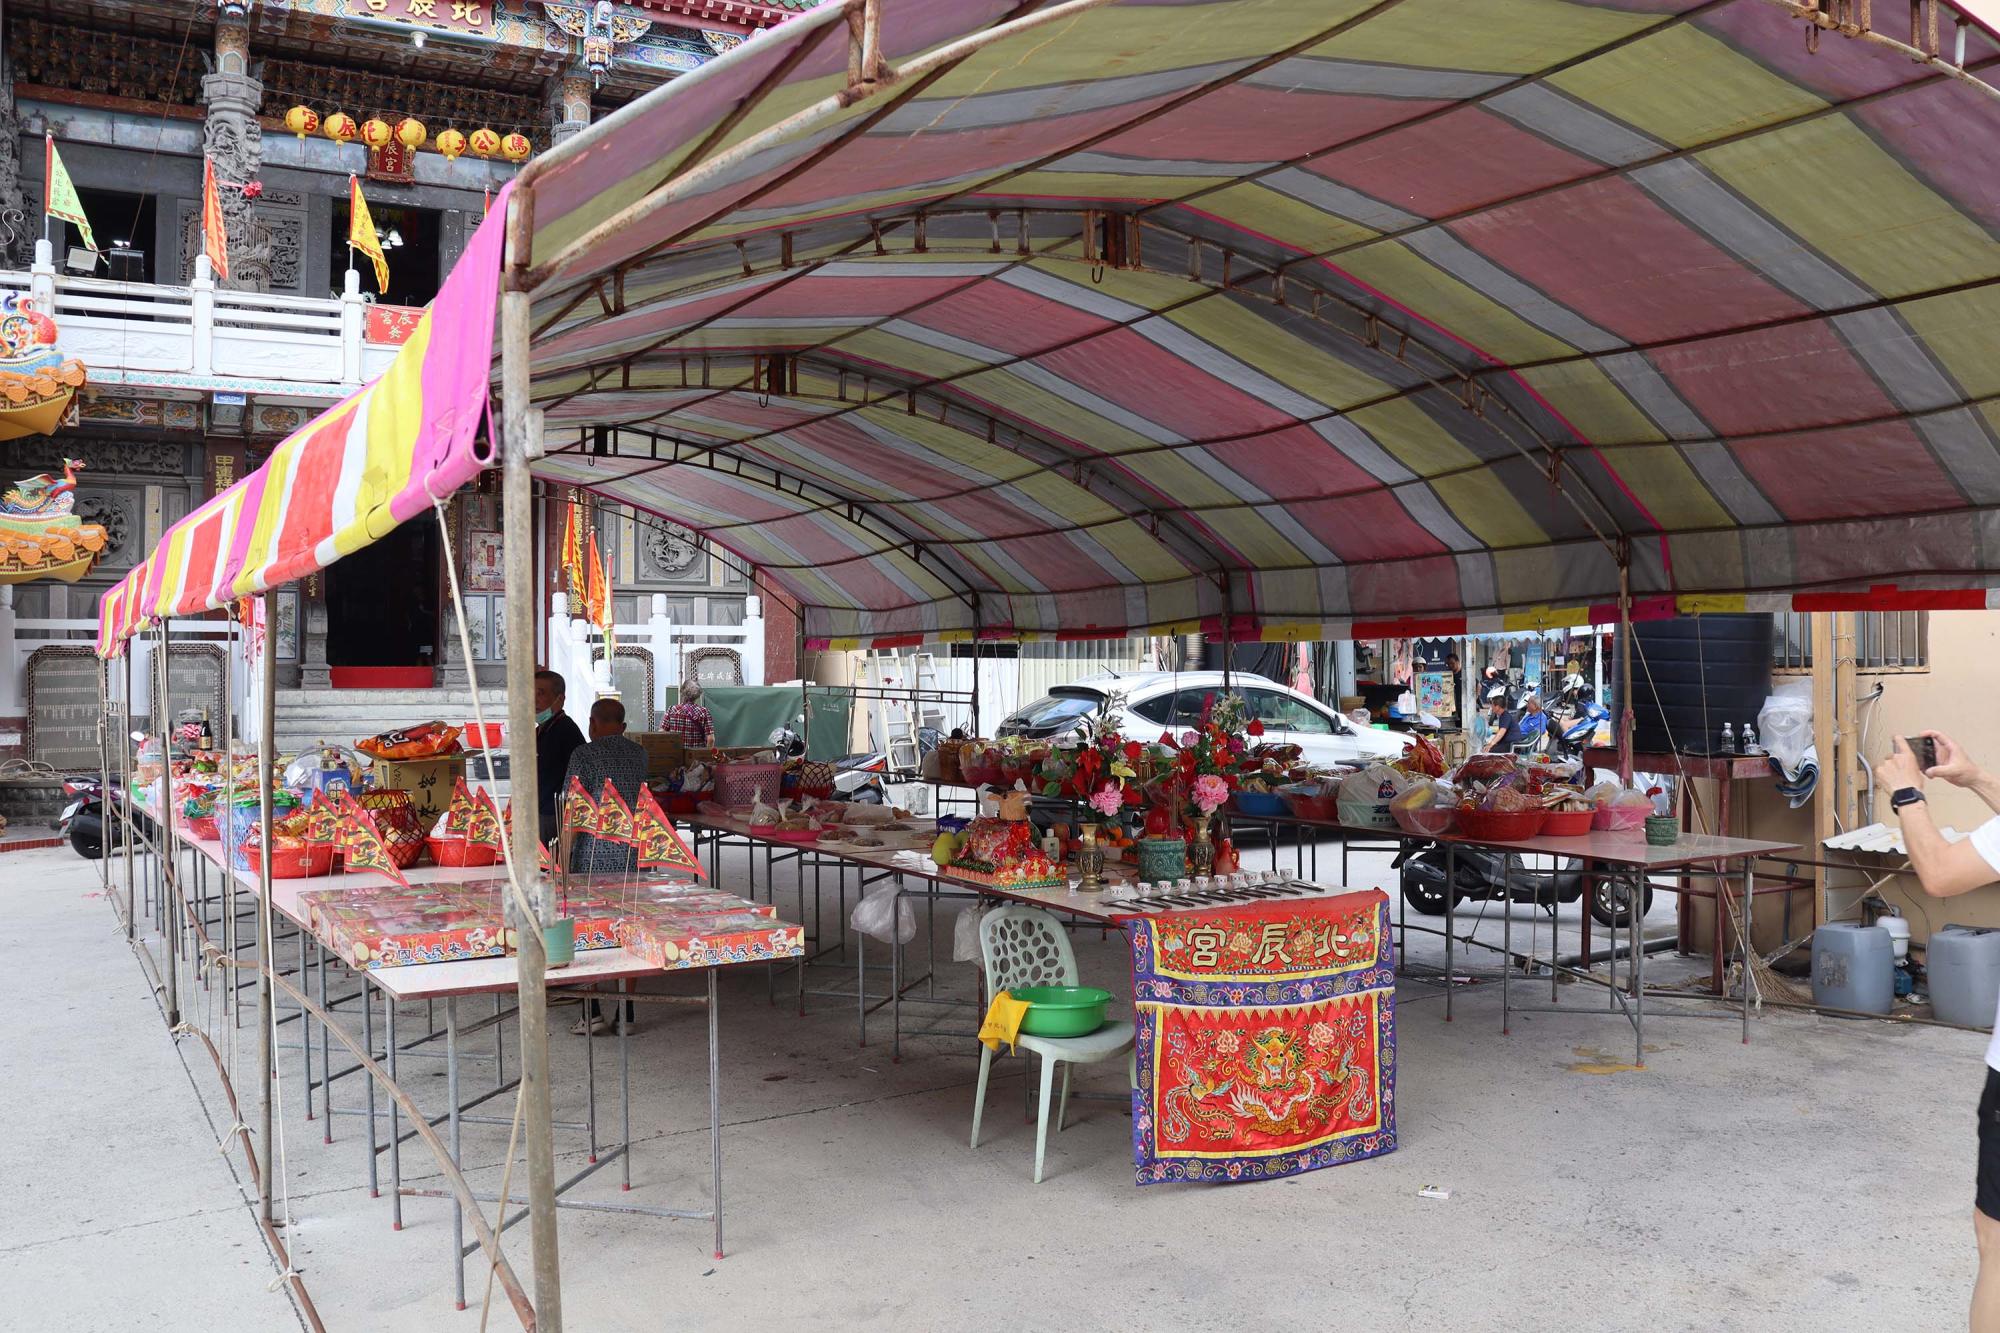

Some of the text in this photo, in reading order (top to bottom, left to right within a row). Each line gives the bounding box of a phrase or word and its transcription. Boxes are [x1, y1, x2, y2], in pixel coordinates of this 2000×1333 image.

[474, 130, 495, 152] 公
[507, 135, 529, 155] 馬
[1185, 922, 1351, 968] 北辰宮
